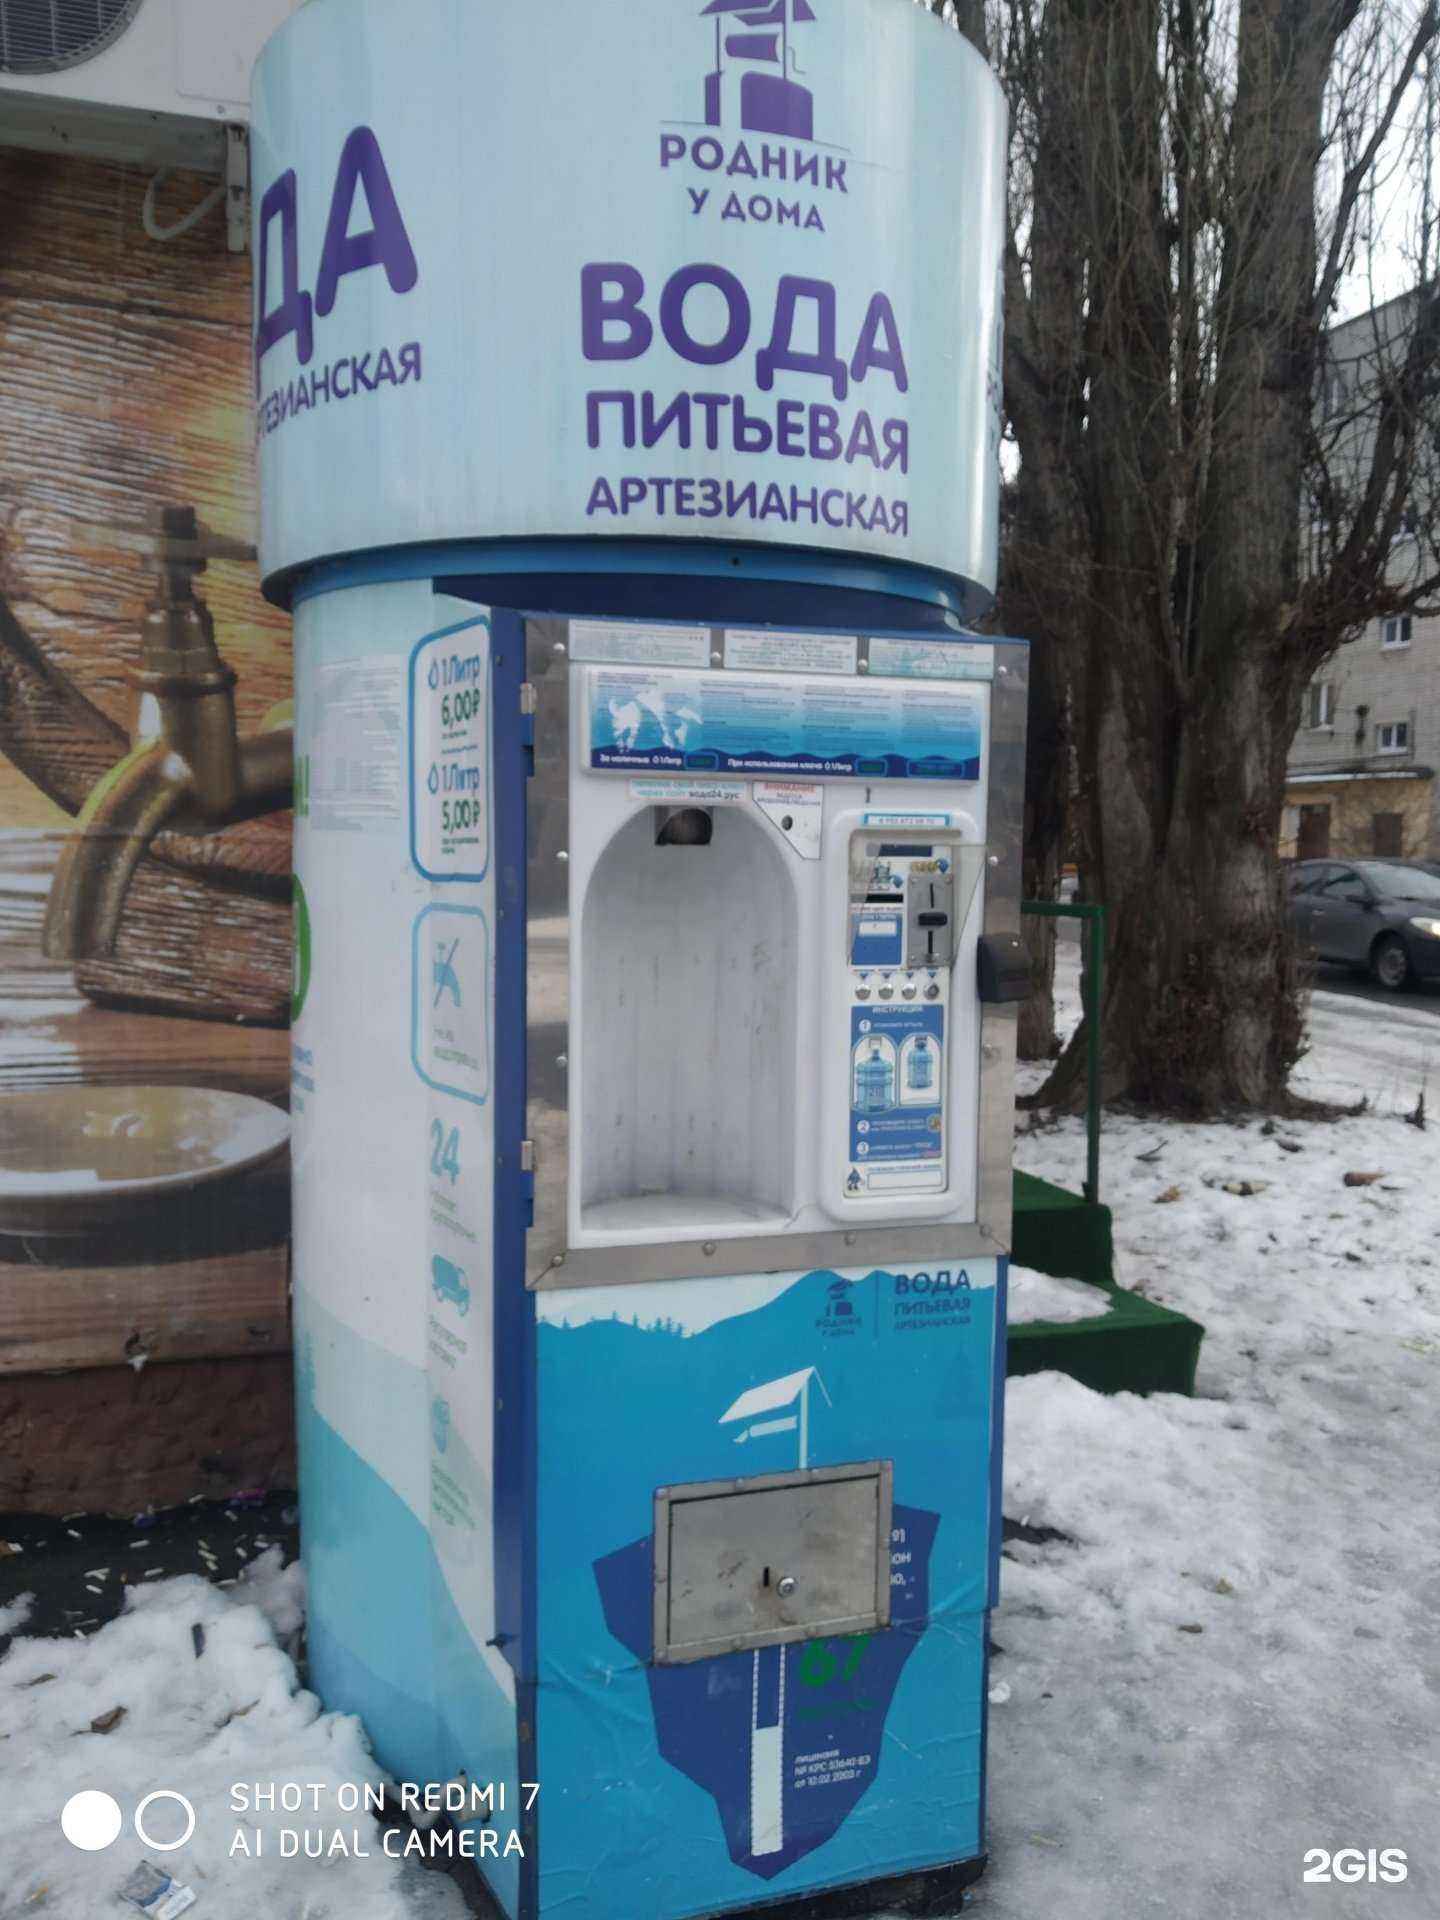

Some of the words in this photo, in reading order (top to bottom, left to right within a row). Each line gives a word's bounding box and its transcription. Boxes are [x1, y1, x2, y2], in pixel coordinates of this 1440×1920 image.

[660, 134, 848, 193] РОДНИК
[687, 187, 710, 216] У
[721, 191, 825, 233] ДОМА
[580, 262, 909, 402] ВОДА
[585, 390, 909, 475] ПИТЬЕВАЯ
[585, 476, 909, 537] АРТЕЗИАНСКАЯ
[895, 1269, 971, 1296] ВОДА
